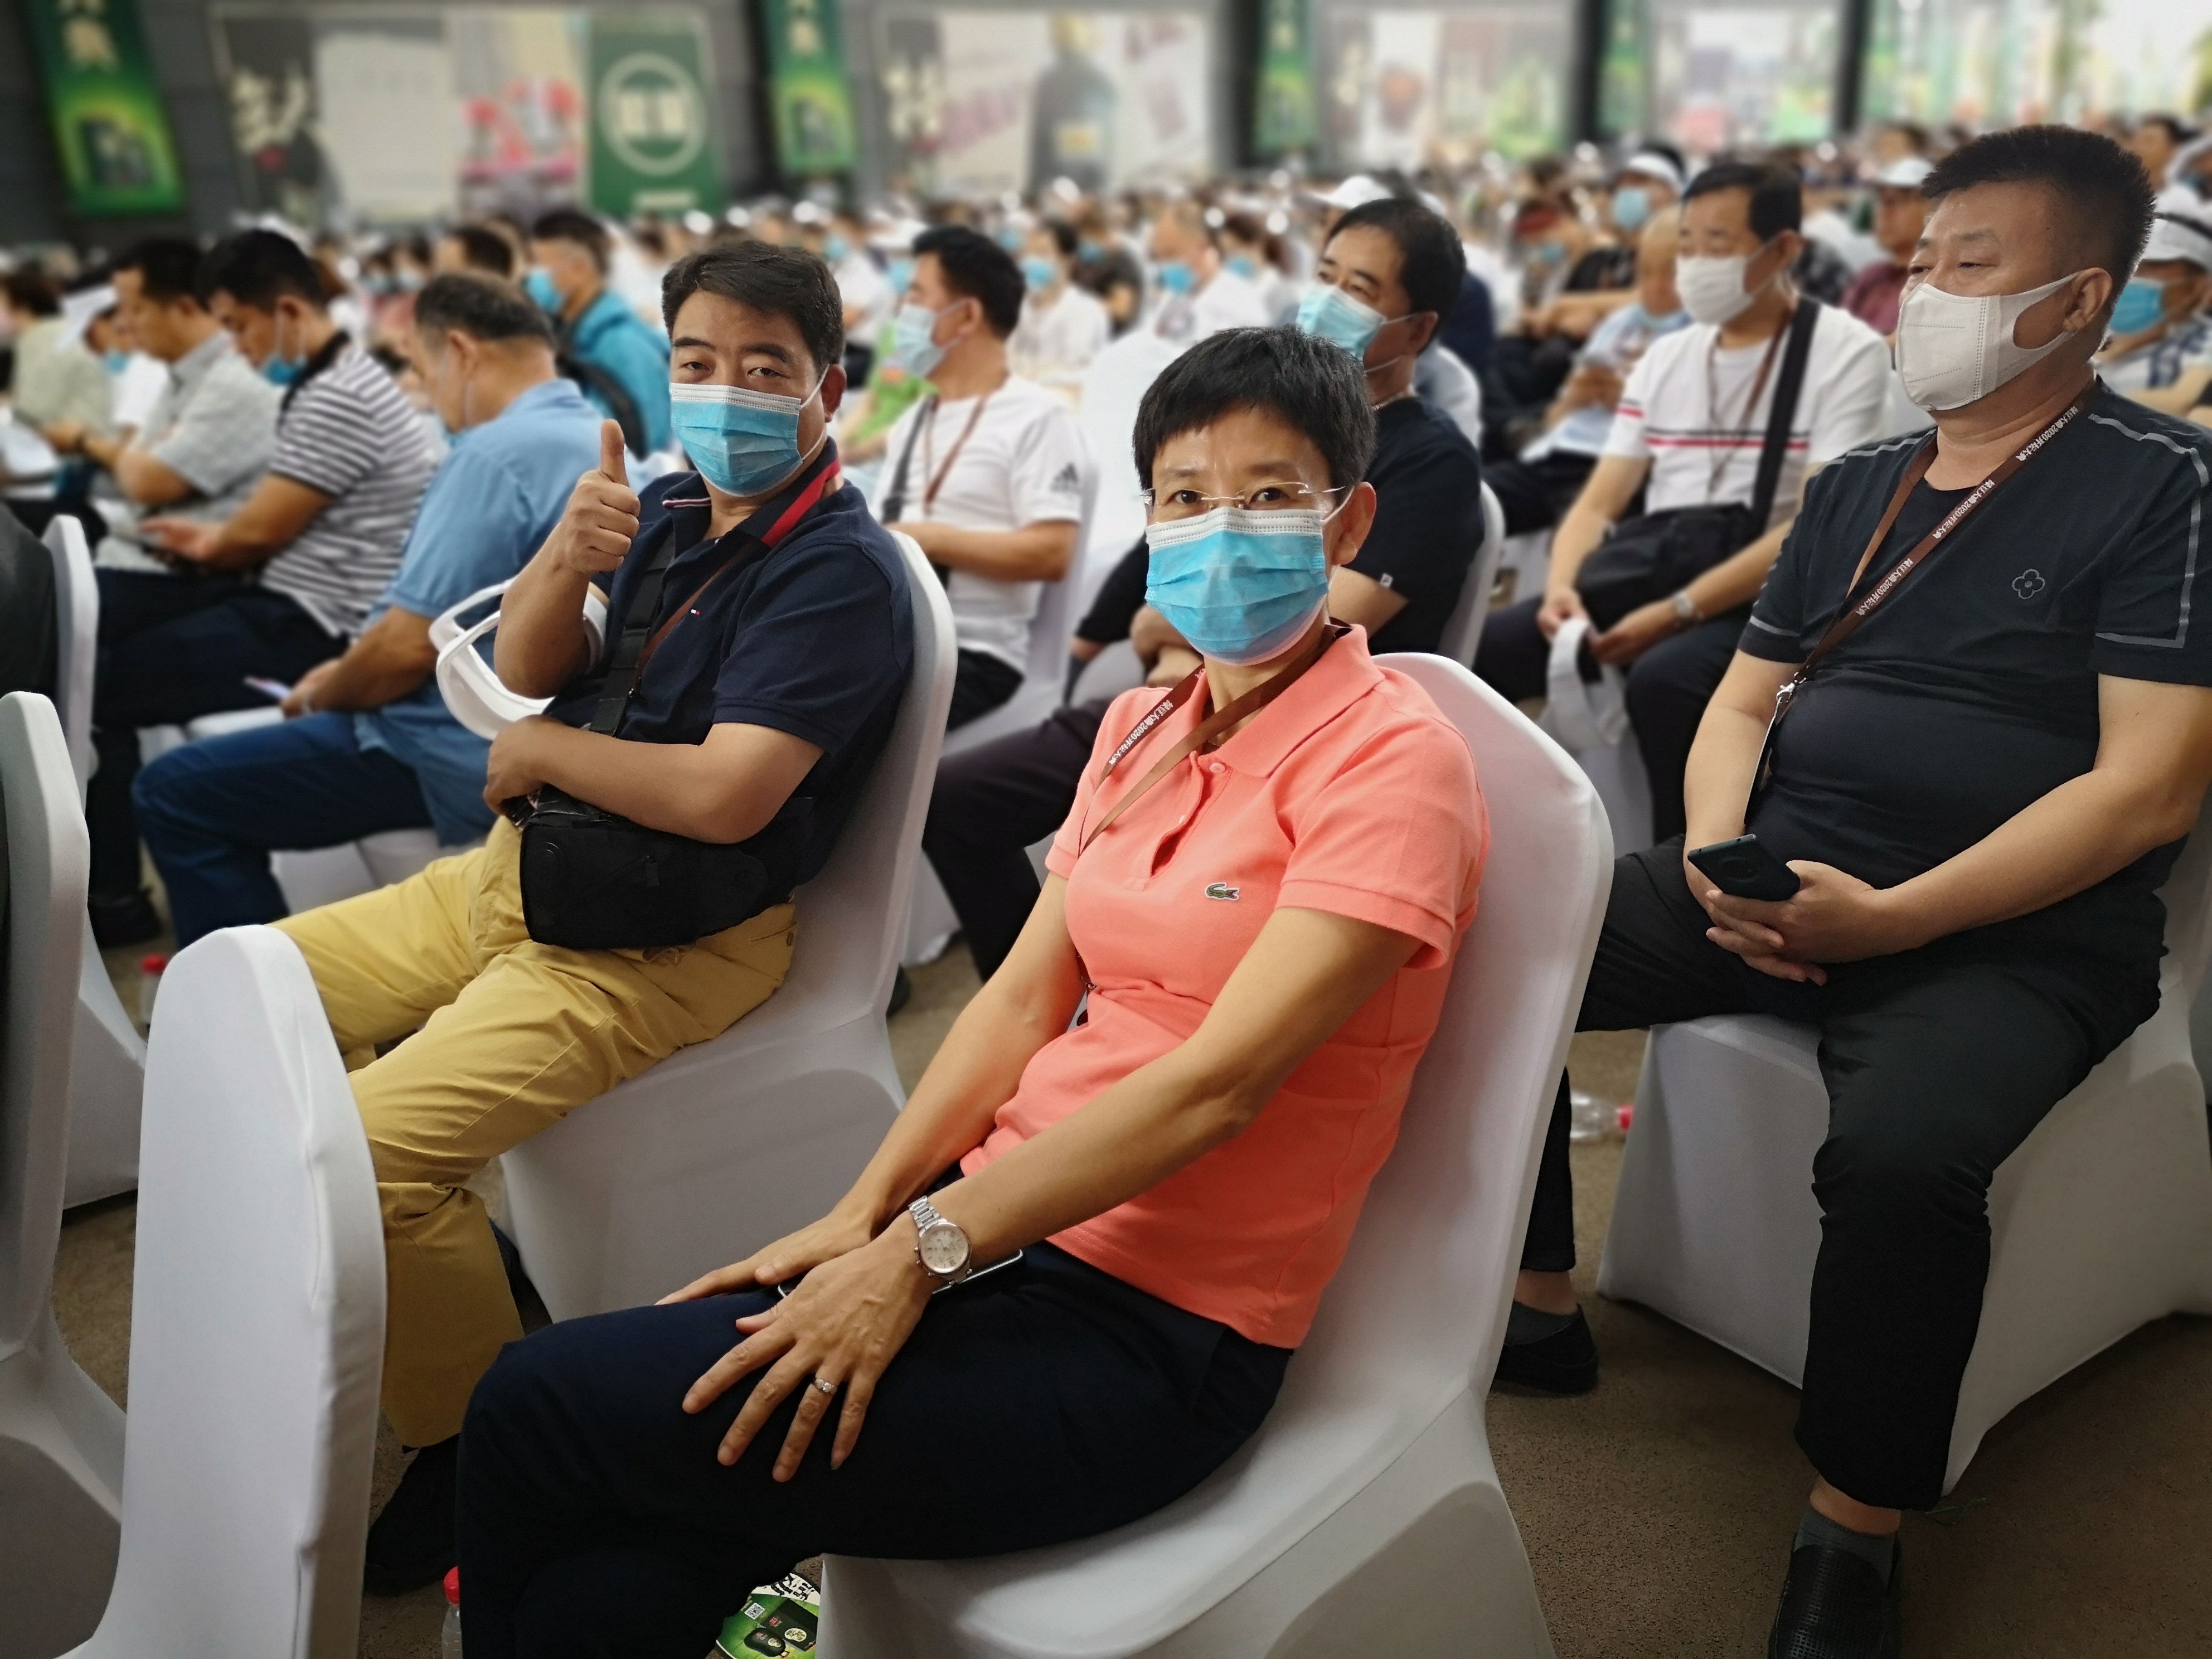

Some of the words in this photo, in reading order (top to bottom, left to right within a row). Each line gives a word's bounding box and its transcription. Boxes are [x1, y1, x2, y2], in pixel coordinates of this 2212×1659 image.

[2016, 405, 2078, 462] 绿豆大曲2020开坛大典
[1933, 479, 1995, 539] 绿豆大曲2020开坛大典
[1856, 558, 1913, 615] 绿豆大曲2020开坛大典
[1109, 700, 1173, 765] 绿豆大曲2020开坛大典
